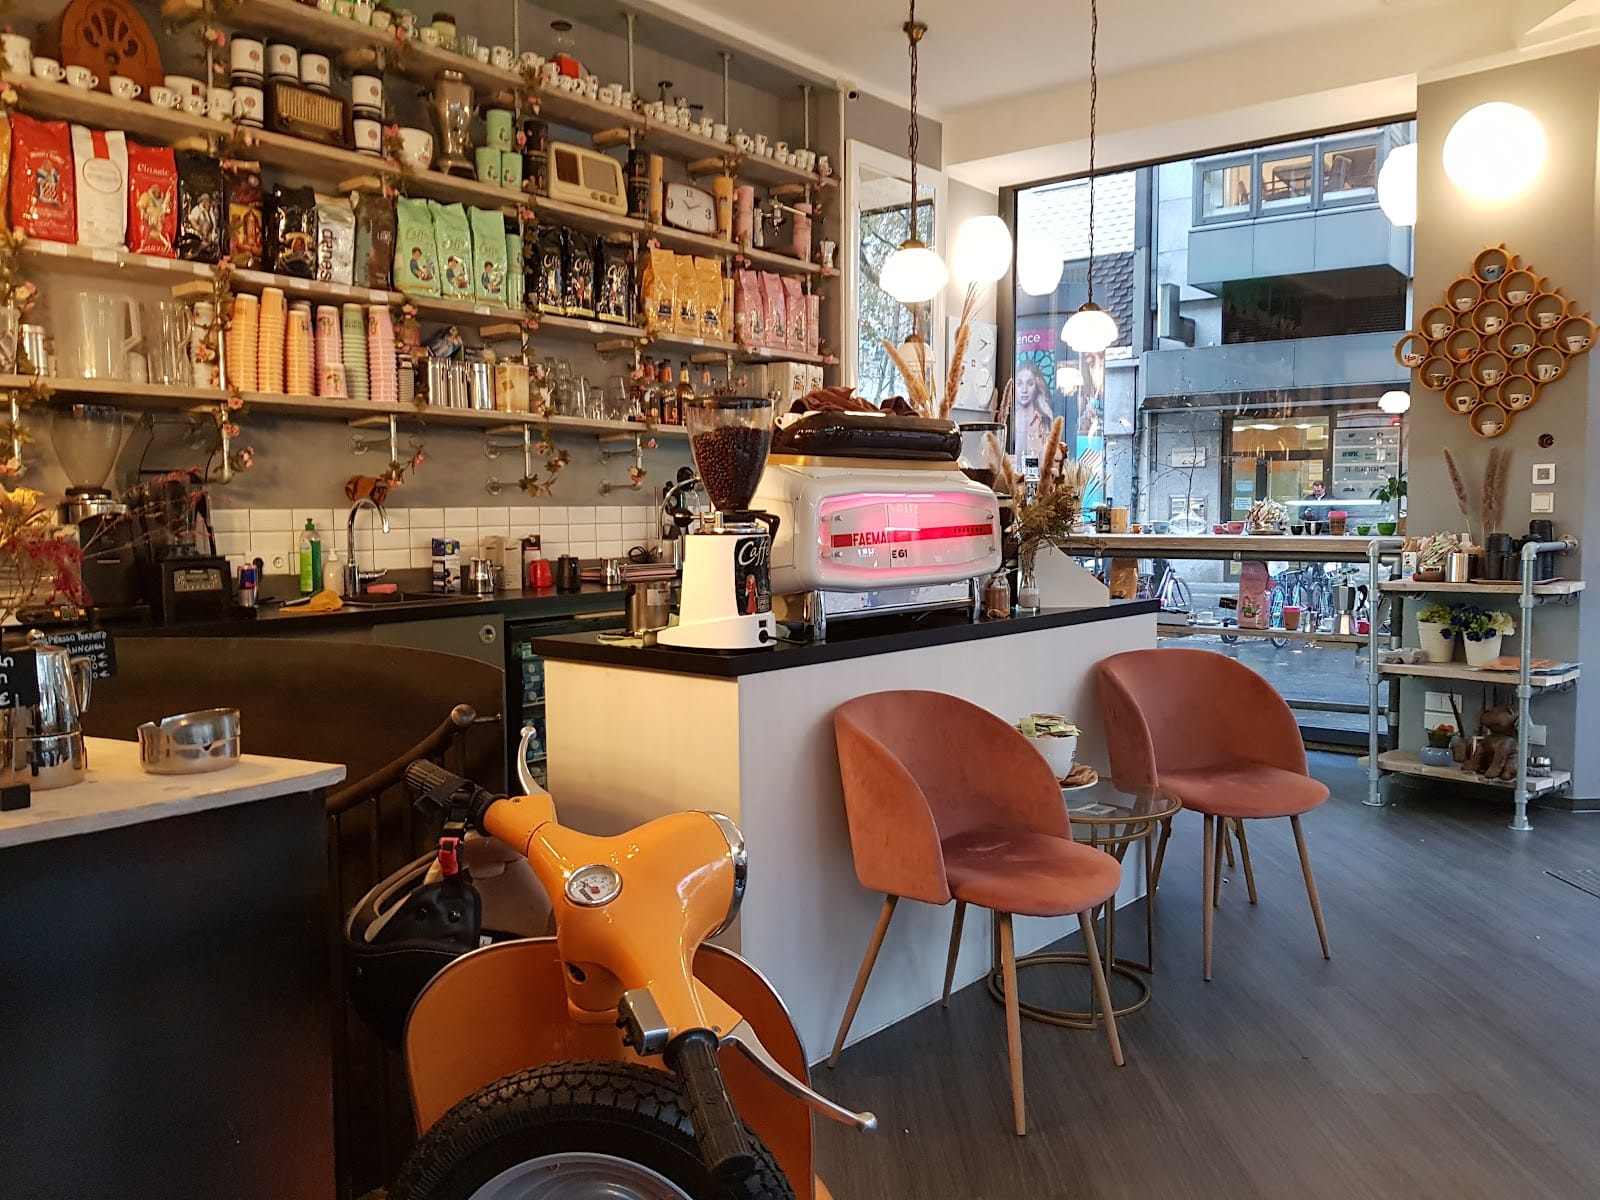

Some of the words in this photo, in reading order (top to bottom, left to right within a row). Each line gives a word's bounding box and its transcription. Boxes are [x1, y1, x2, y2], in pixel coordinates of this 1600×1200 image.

[686, 189, 694, 198] 12
[705, 208, 711, 220] 3
[1016, 333, 1041, 345] ence
[852, 531, 887, 547] FAEMA
[42, 635, 75, 645] SPRESSO
